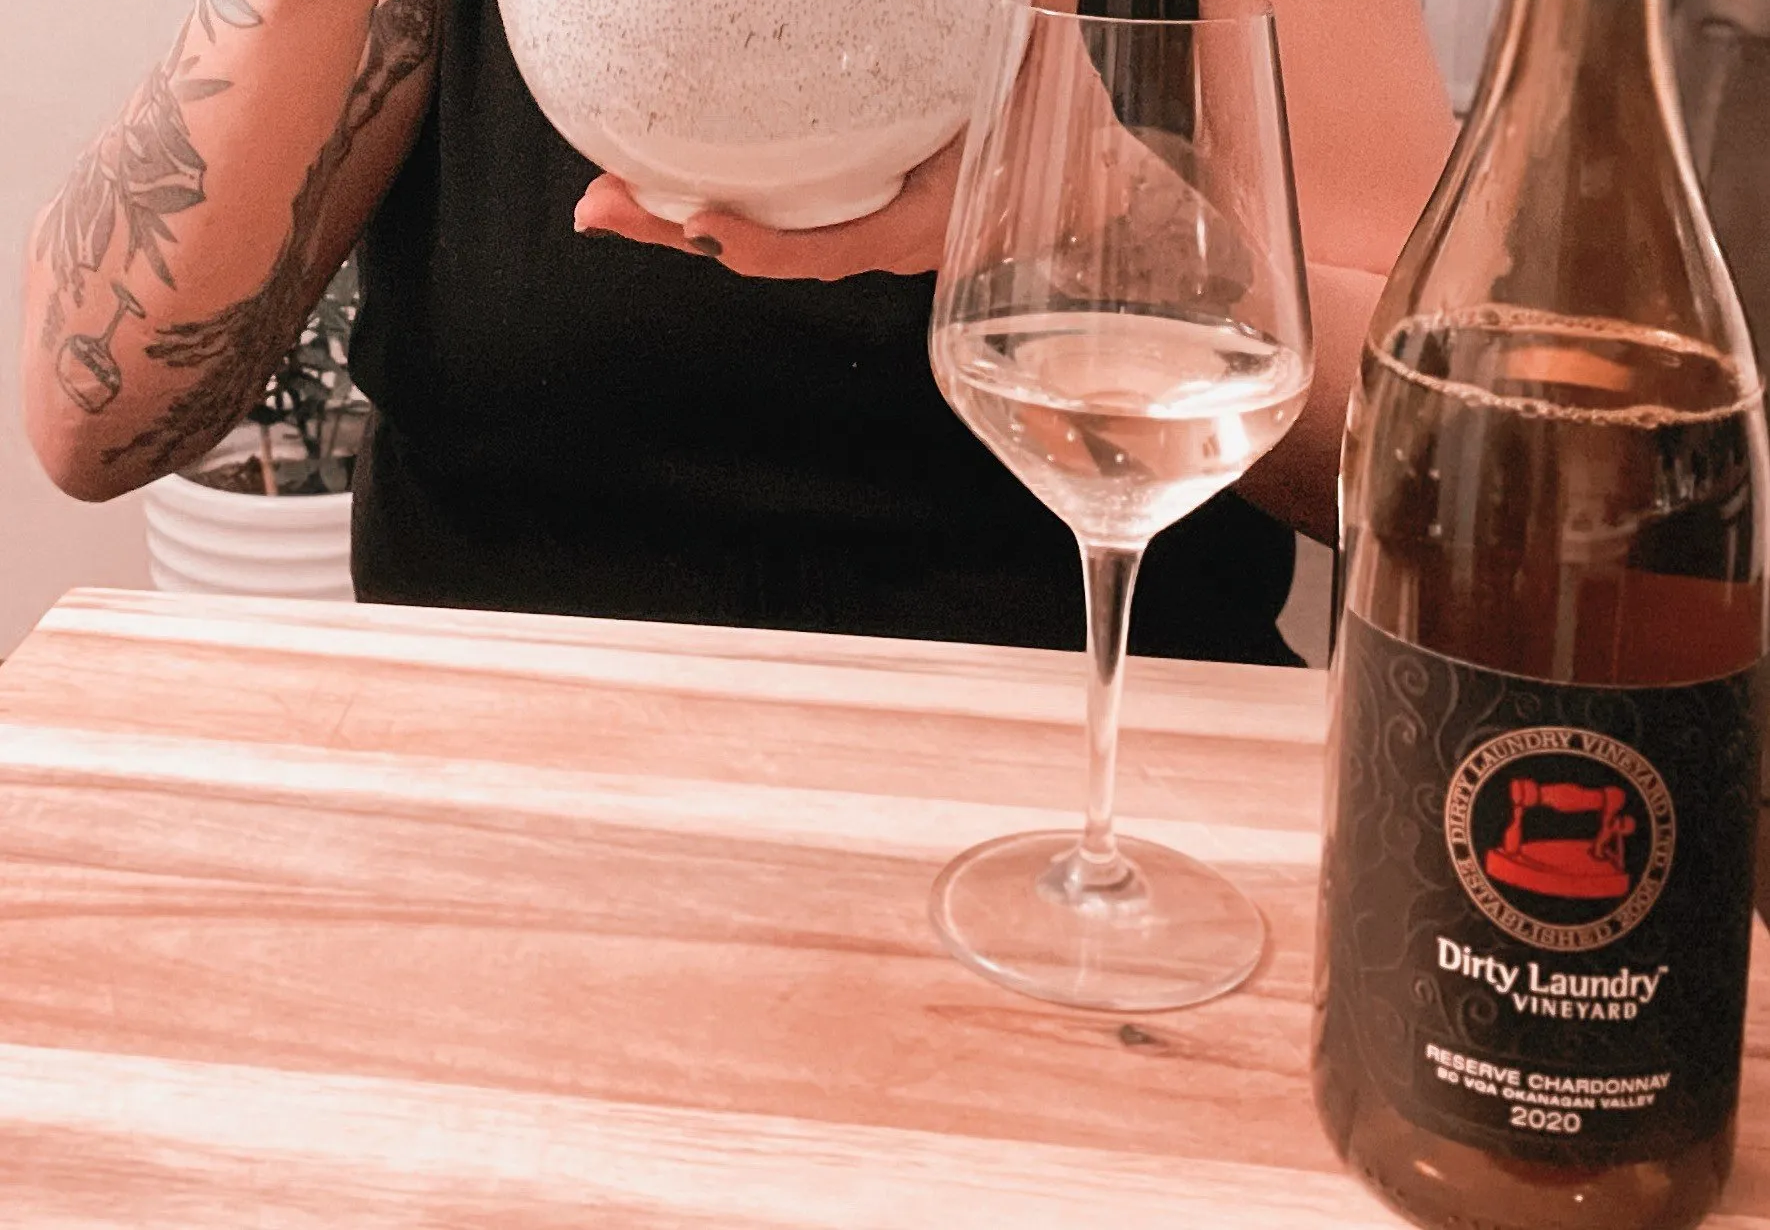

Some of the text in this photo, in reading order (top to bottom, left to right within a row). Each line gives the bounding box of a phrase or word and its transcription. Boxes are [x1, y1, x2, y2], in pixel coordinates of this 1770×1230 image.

[1449, 773, 1477, 845] DIRTY
[1468, 731, 1573, 776] LAUNDRY
[1456, 858, 1612, 947] ESTABLISHED
[1437, 936, 1660, 1003] Dirty Laundry
[1512, 992, 1638, 1020] VINEYARD
[1425, 1043, 1671, 1095] RESERVE CHARDONNAY
[1501, 1087, 1596, 1109] OKANAGAN
[1600, 1093, 1656, 1110] VALLEY
[1510, 1105, 1582, 1133] 2020
